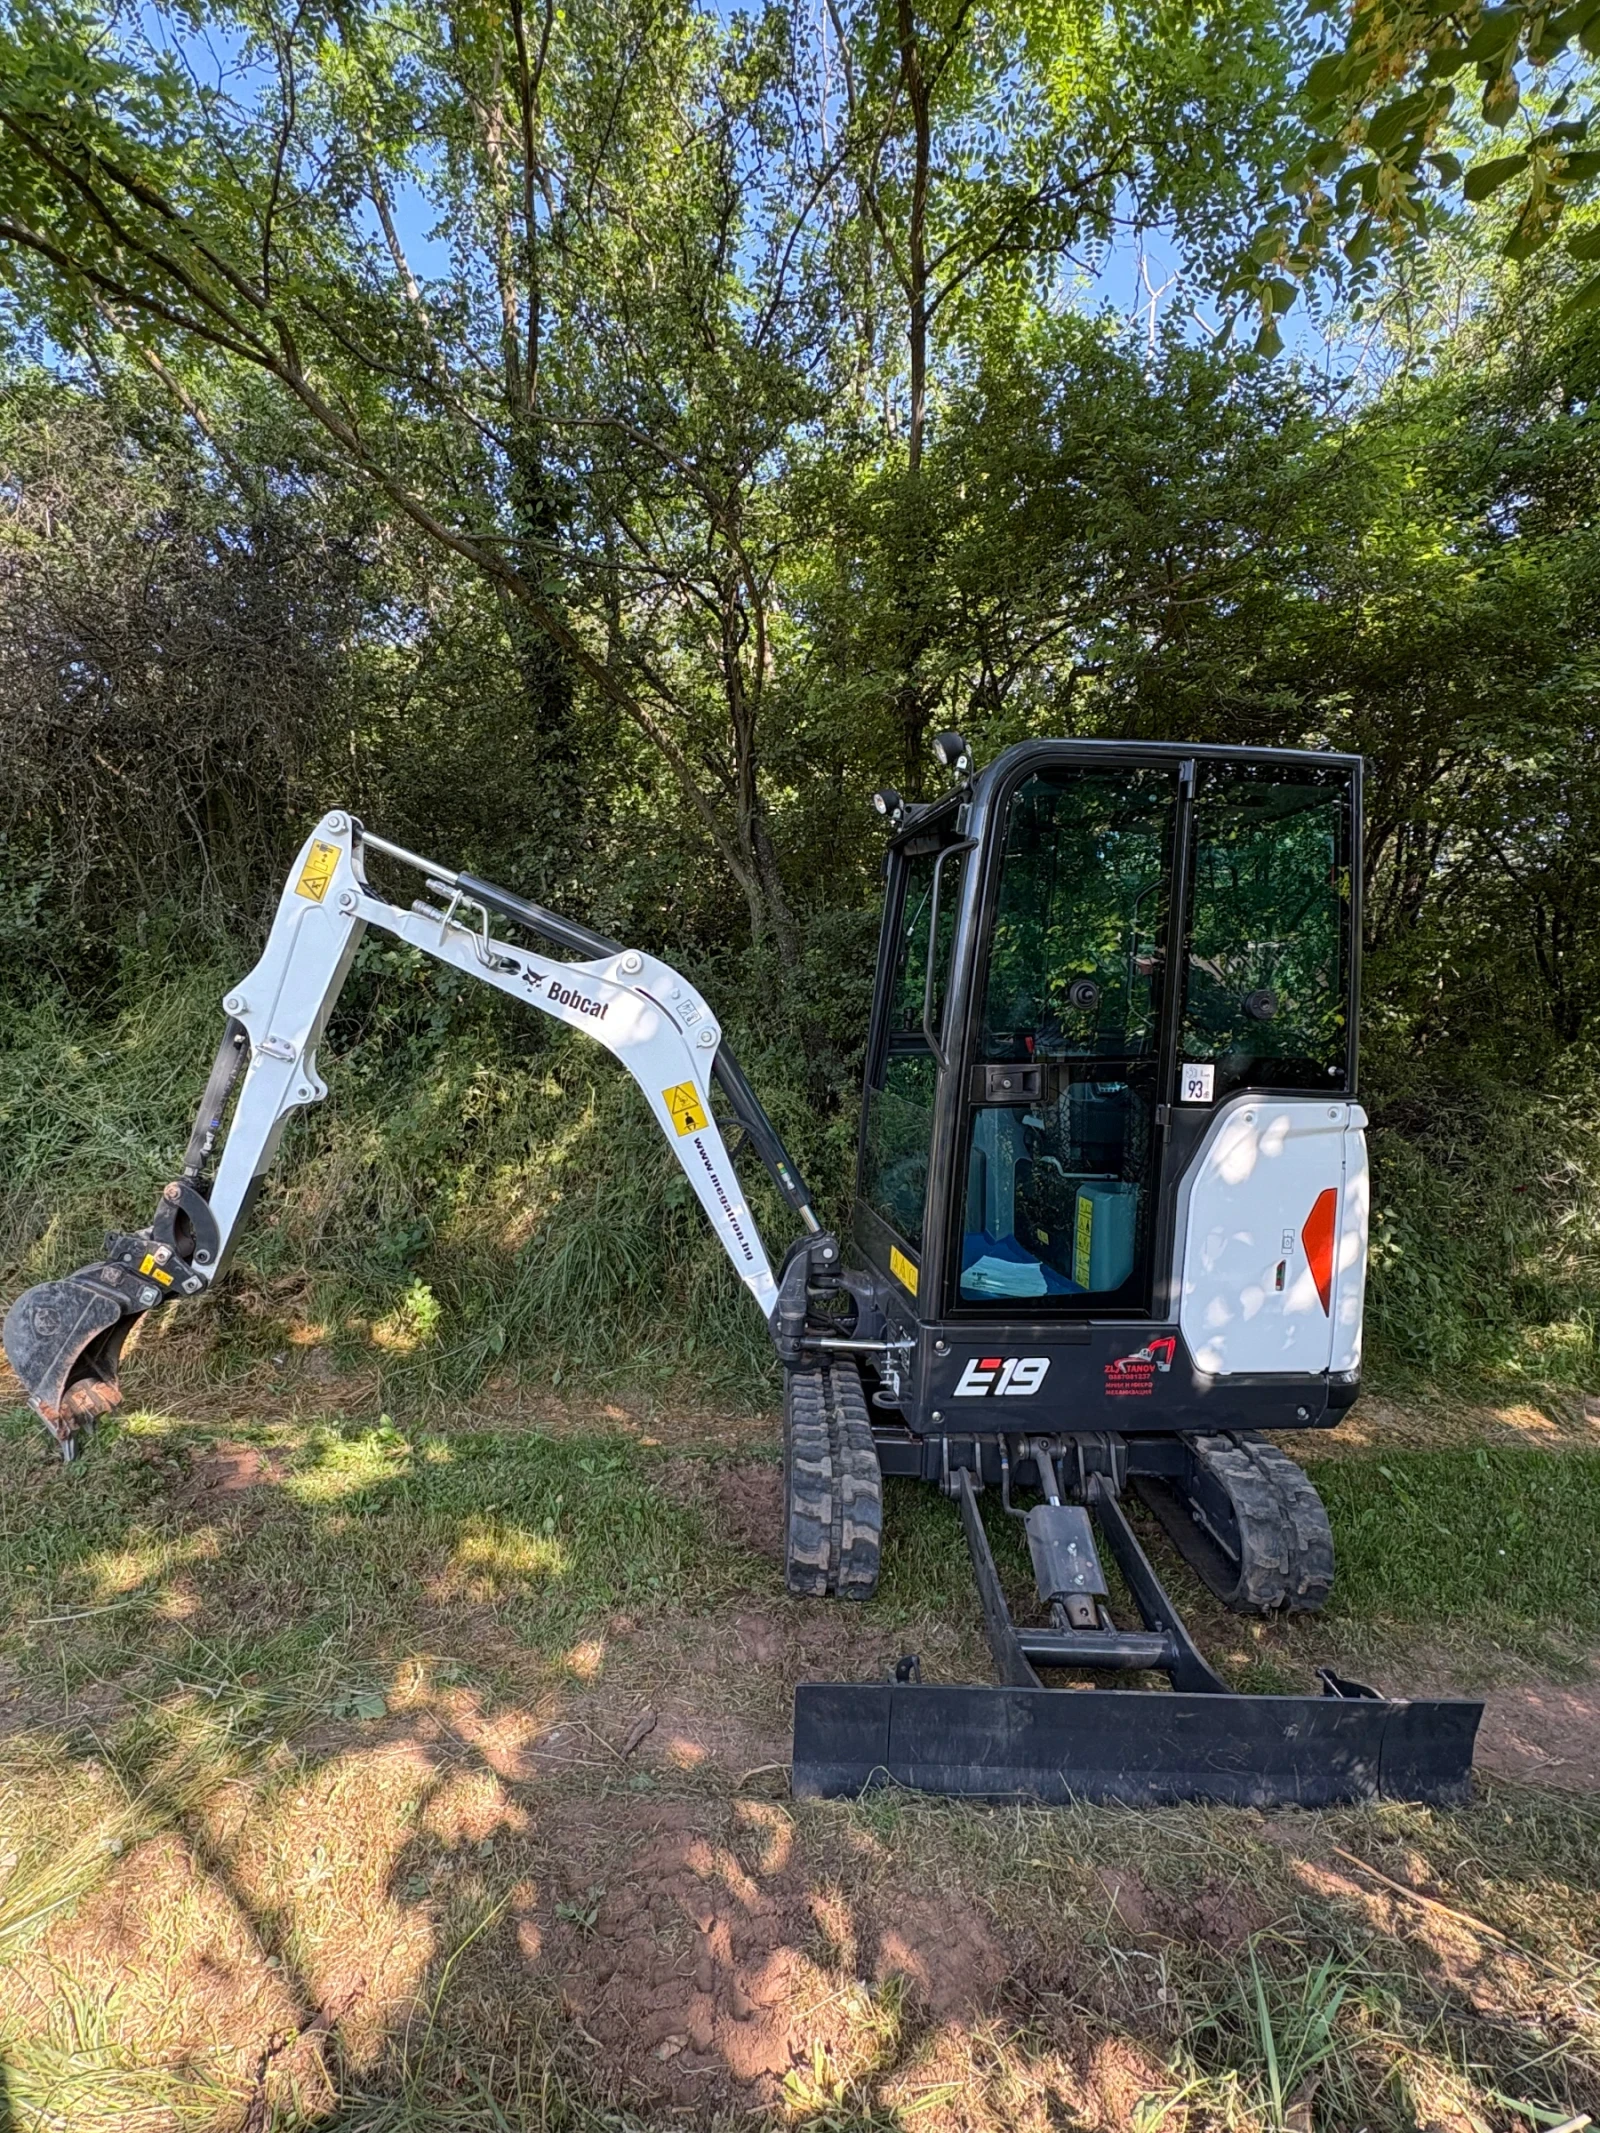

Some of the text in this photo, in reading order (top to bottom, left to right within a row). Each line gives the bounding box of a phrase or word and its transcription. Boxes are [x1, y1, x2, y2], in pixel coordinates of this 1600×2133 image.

[547, 981, 609, 1021] Bobcat
[1188, 1080, 1203, 1099] 93
[694, 1137, 754, 1261] www.megatron.bg
[953, 1357, 1051, 1397] E19
